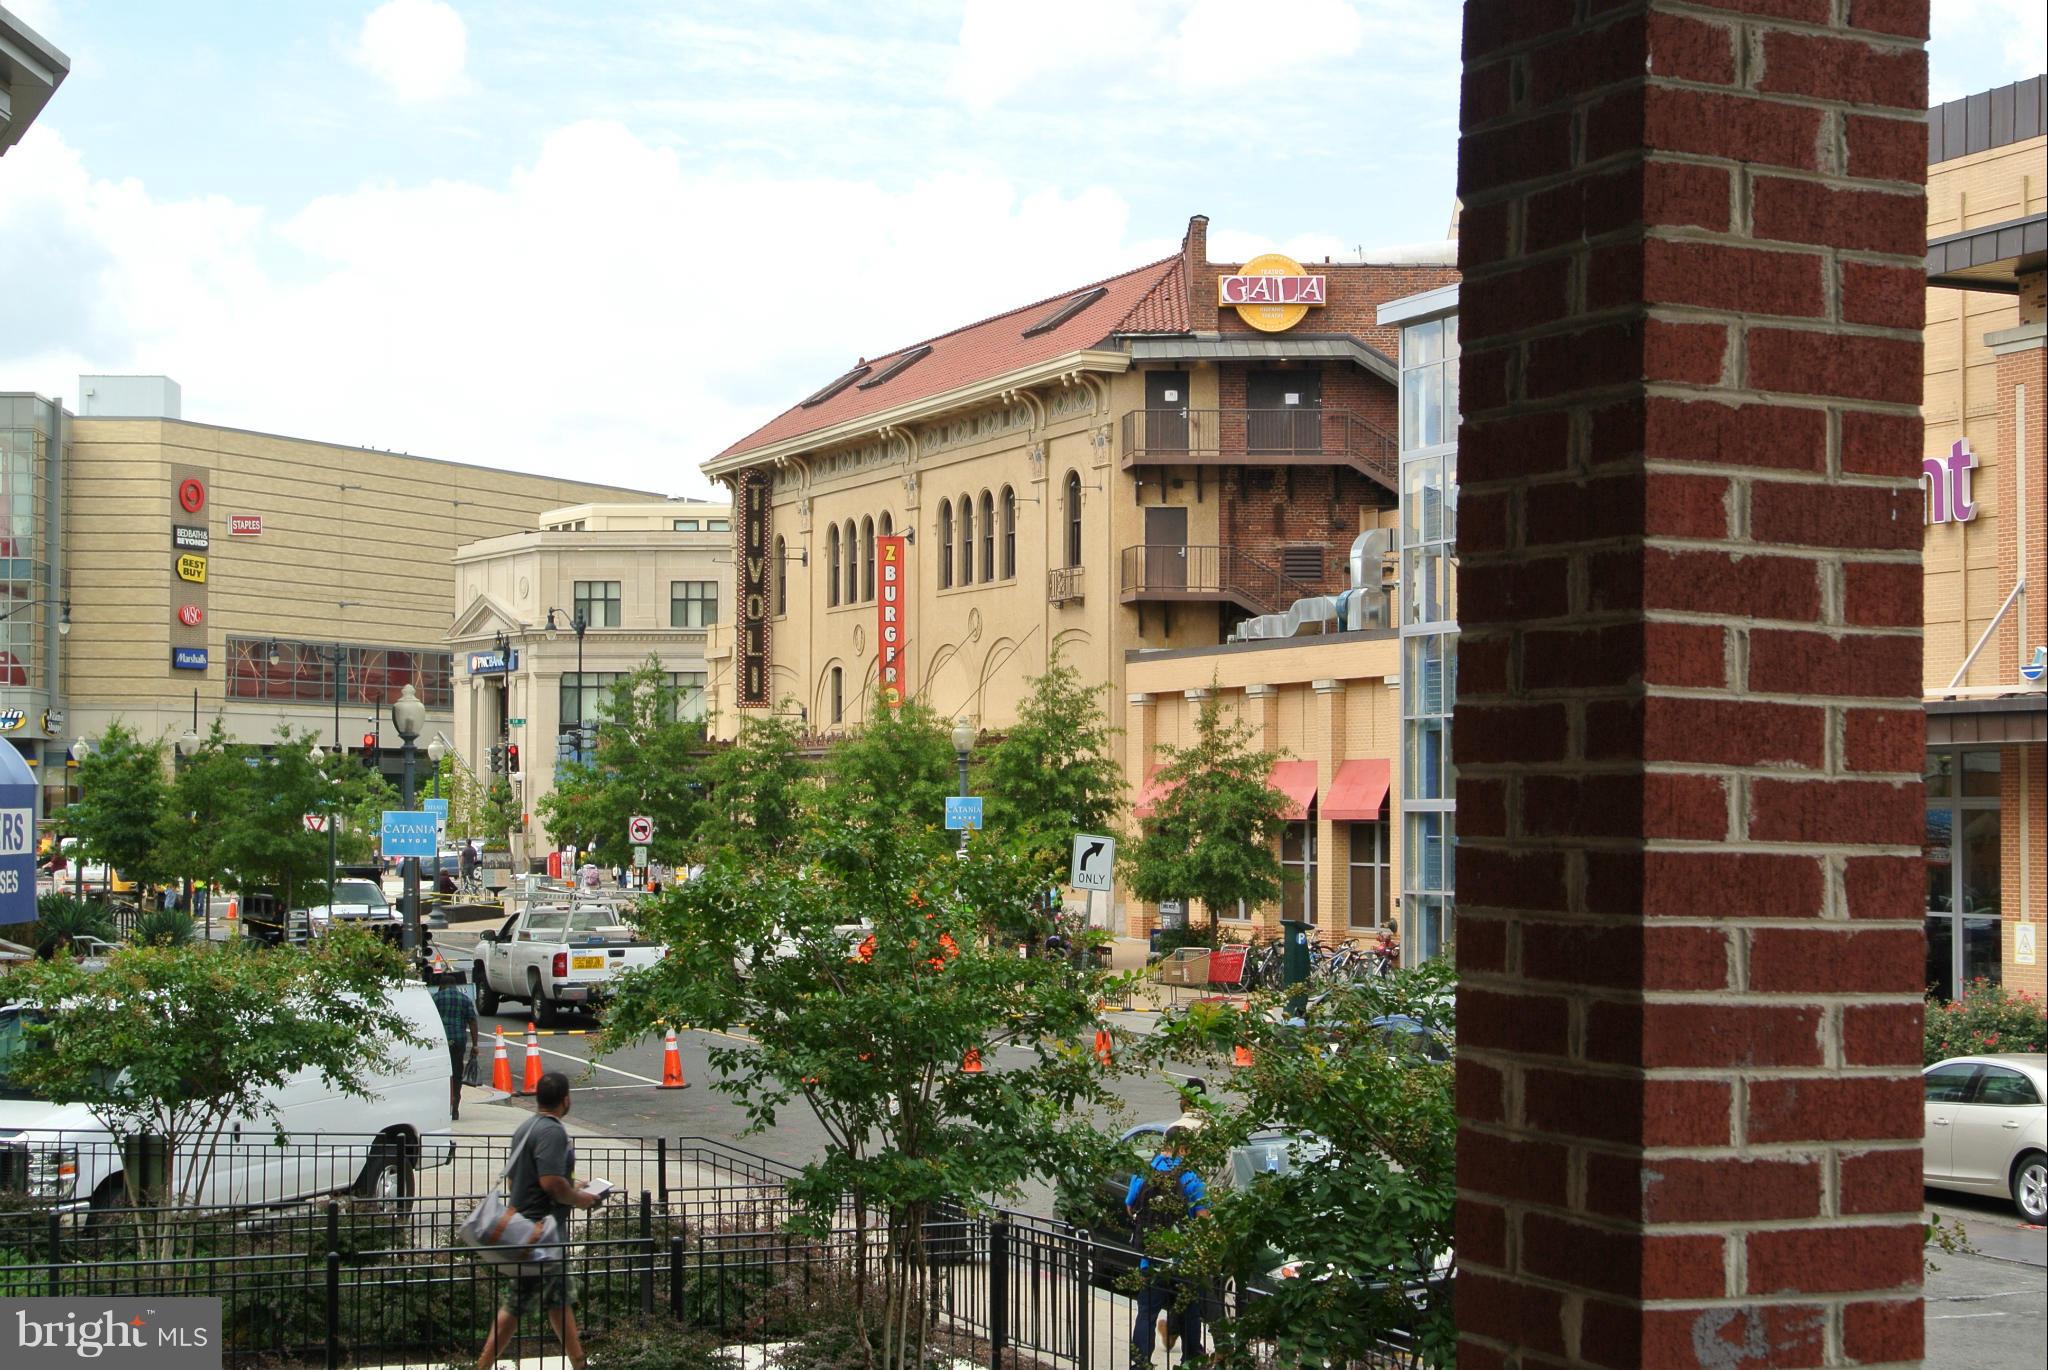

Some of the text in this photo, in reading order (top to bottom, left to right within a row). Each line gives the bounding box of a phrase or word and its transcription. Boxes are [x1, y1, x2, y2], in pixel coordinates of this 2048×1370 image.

[1222, 276, 1322, 303] GALA
[232, 519, 261, 531] STAPLES
[177, 528, 189, 537] BED
[177, 537, 208, 547] BEYOND
[182, 558, 205, 570] BEST
[183, 567, 202, 578] BUY
[746, 484, 765, 694] TIVOLI
[183, 606, 201, 624] WSC
[177, 652, 207, 664] Marshalls
[383, 823, 436, 834] CATANIA
[1078, 872, 1106, 885] ONLY
